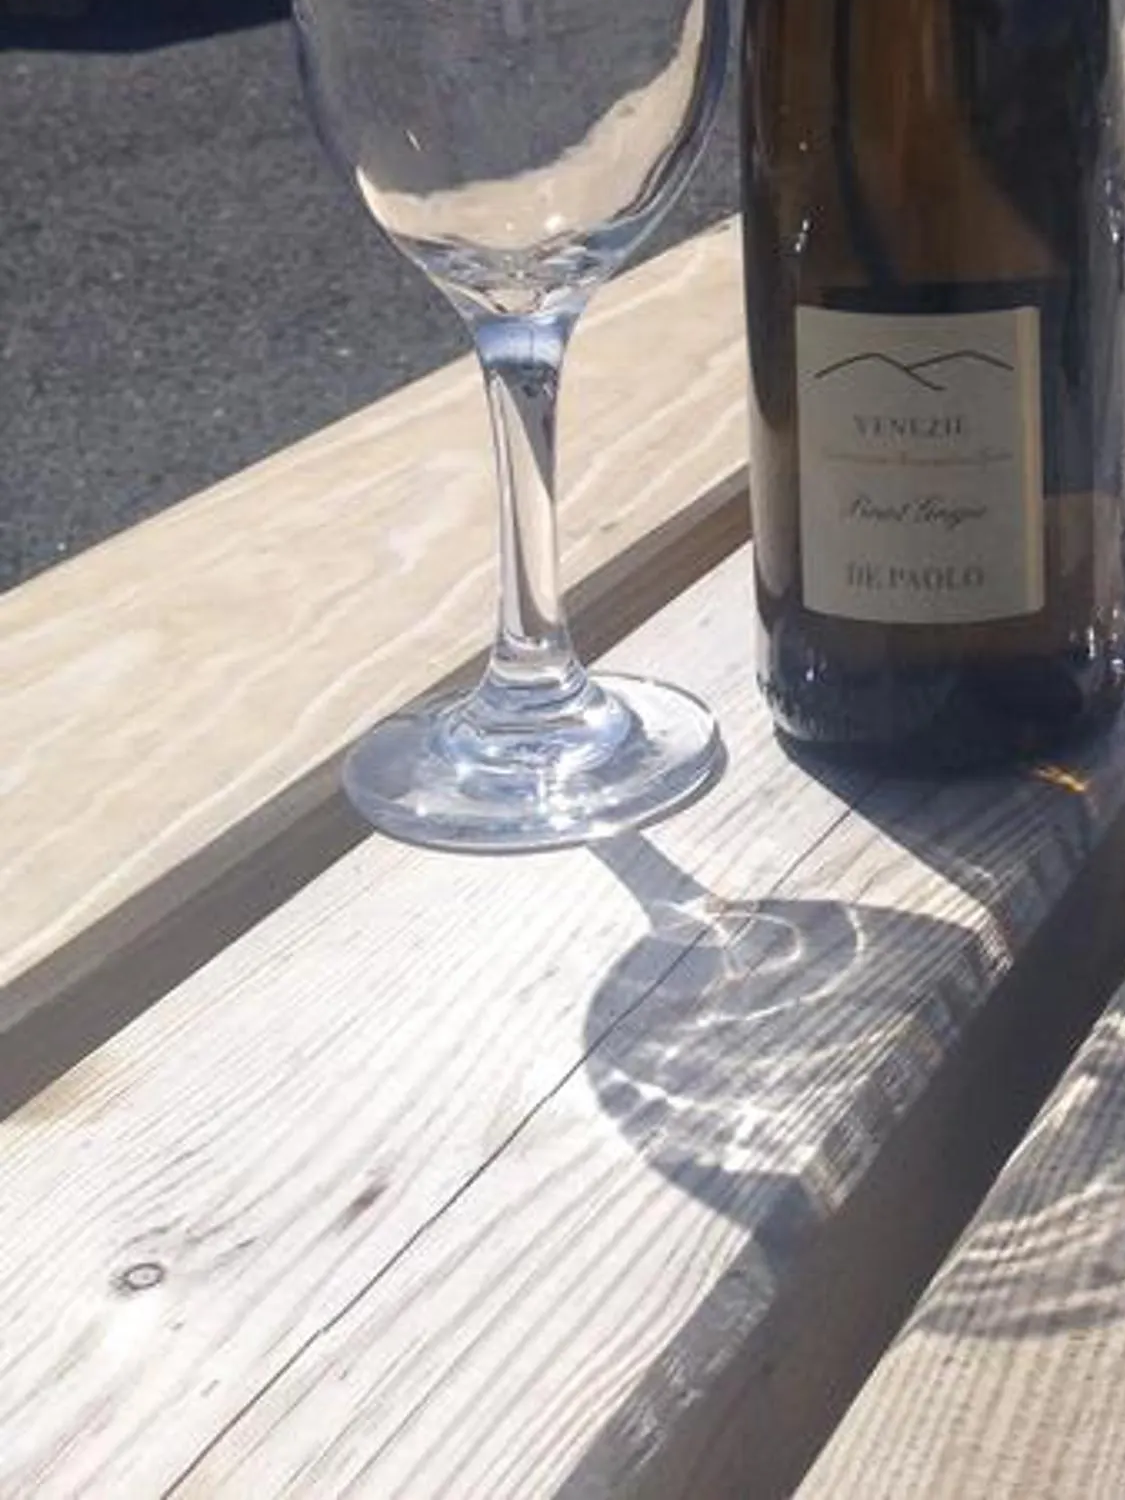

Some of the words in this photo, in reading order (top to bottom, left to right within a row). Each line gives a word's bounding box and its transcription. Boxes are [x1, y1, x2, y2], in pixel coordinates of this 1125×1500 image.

[852, 414, 966, 437] VENEZIE
[846, 562, 883, 590] DE
[889, 565, 986, 591] PAOLO
